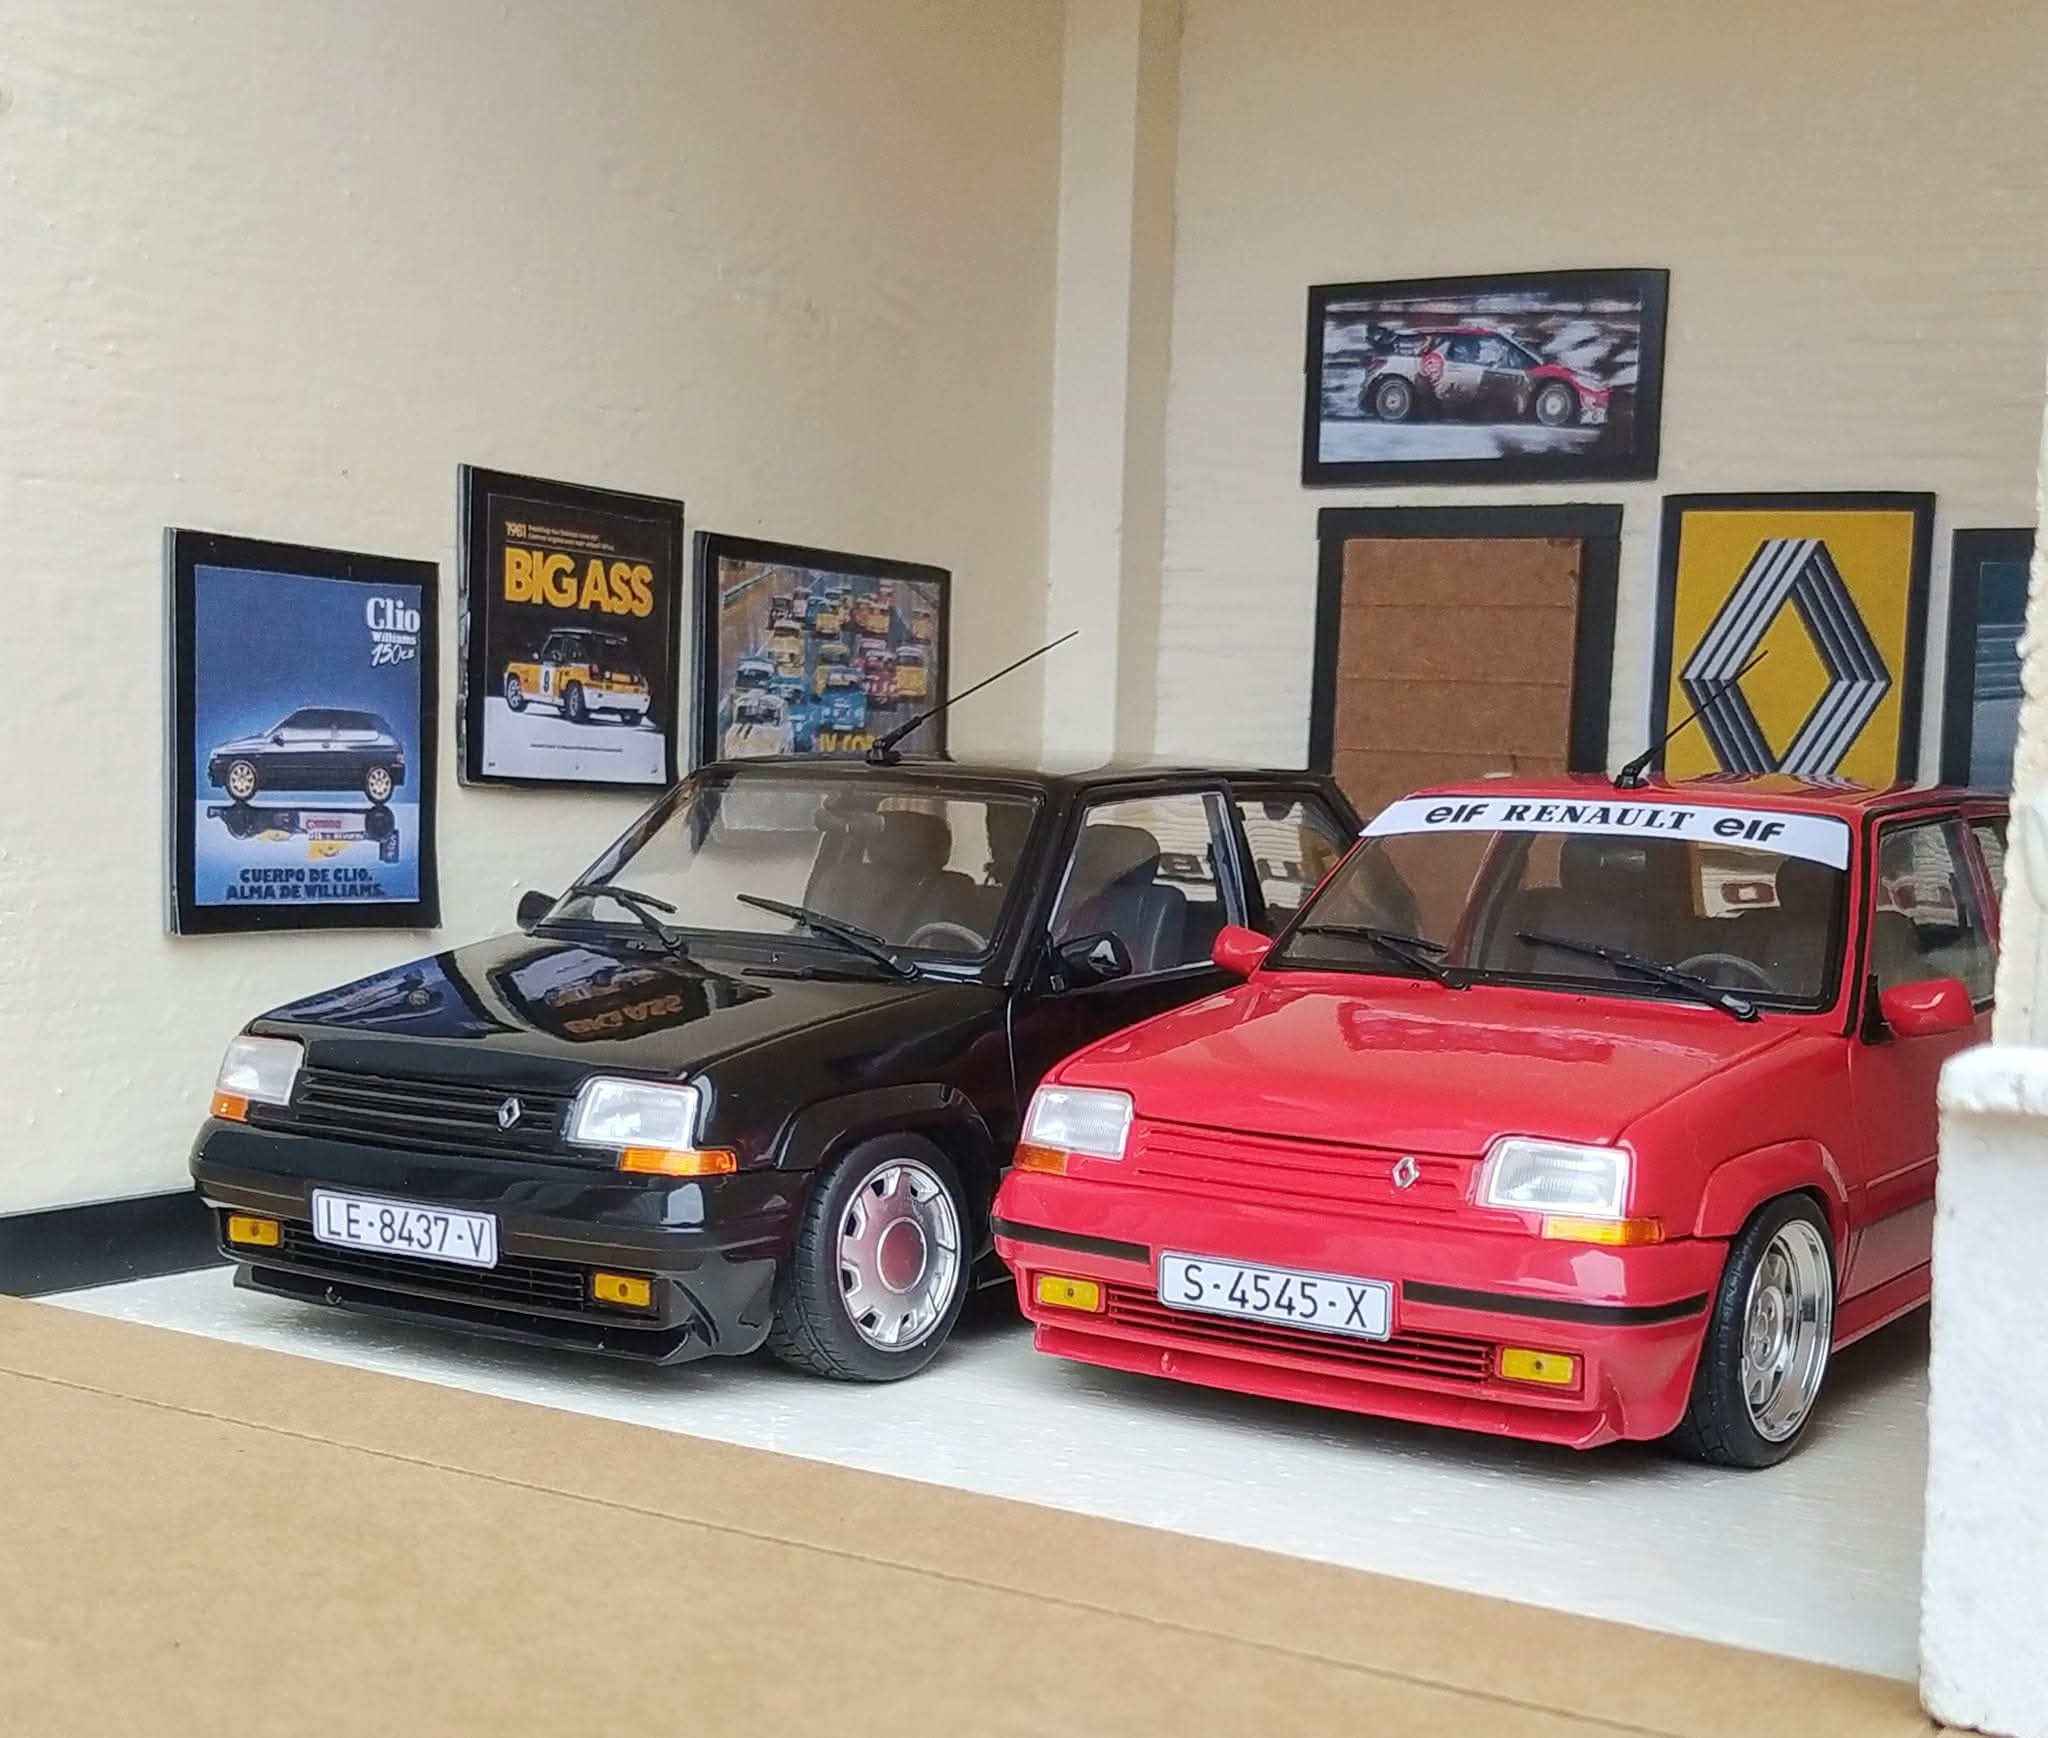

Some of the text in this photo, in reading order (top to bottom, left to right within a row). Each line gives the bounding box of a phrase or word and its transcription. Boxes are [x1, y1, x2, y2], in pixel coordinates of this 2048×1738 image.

[504, 546, 654, 618] BIG ASS
[366, 597, 421, 633] Clio
[1424, 803, 1787, 842] elf RENAULT elf
[226, 883, 280, 901] ALMA
[280, 883, 302, 899] DE
[239, 867, 374, 884] CUERPO DE CLIO.
[325, 1198, 486, 1259] LE-8437-V
[1182, 1263, 1369, 1329] S-4545-X
